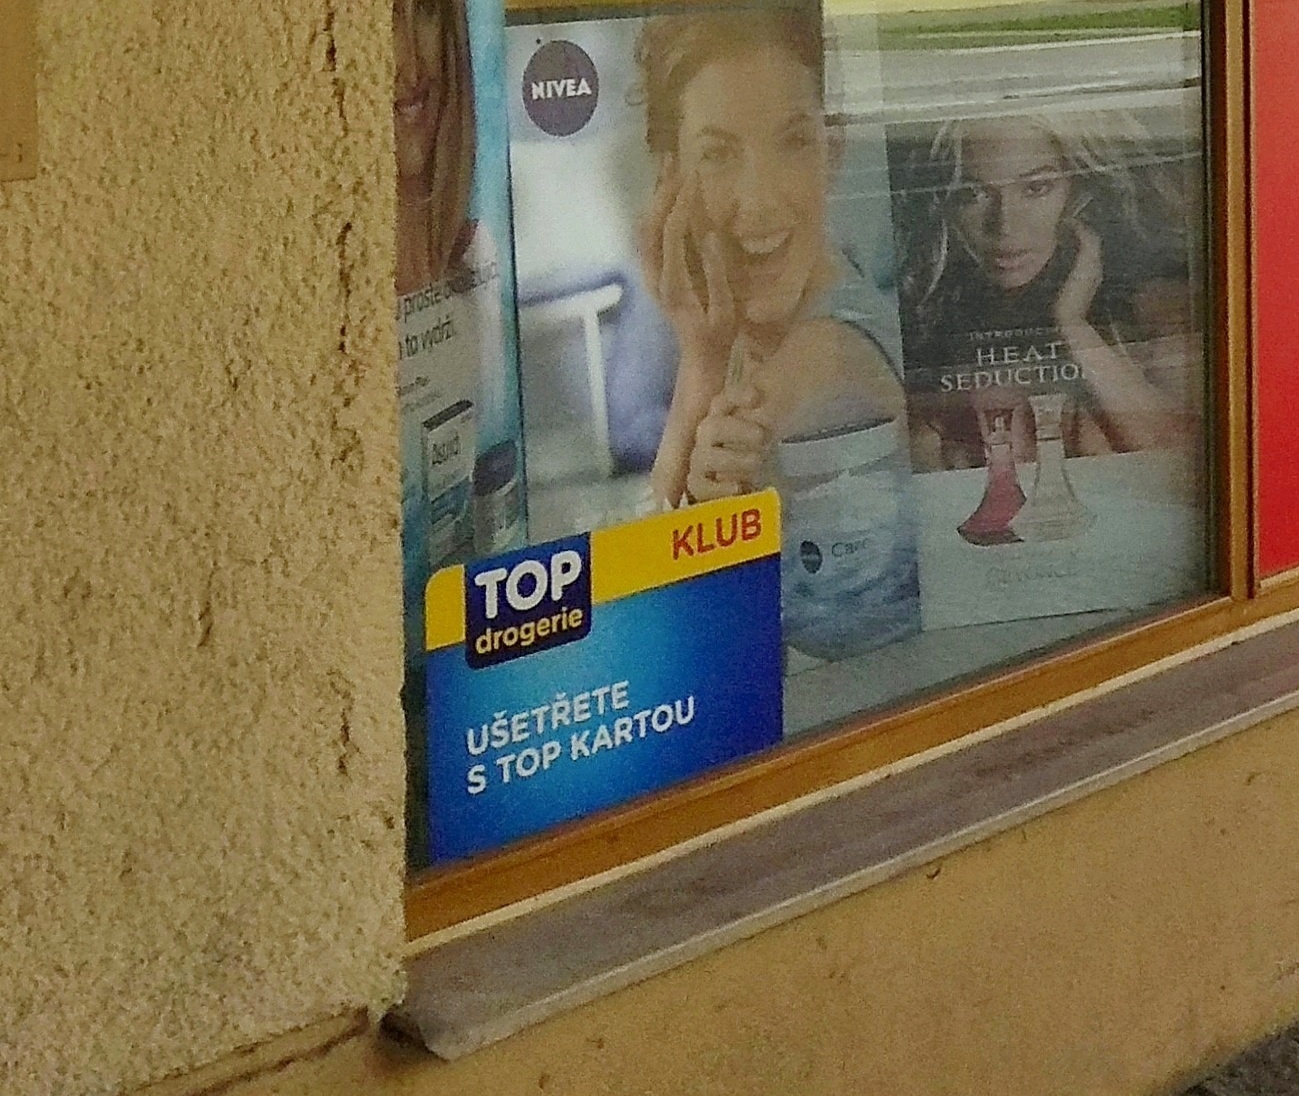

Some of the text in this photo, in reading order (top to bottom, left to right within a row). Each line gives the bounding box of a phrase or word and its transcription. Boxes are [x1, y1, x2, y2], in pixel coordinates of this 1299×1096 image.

[532, 77, 592, 100] NIVEA
[976, 340, 1062, 366] HEAT
[672, 508, 762, 560] KLUB
[474, 550, 582, 619] TOP
[475, 606, 584, 654] drogerie
[467, 680, 630, 756] UŠETŘETE
[466, 695, 695, 795] S TOP KARTOU
